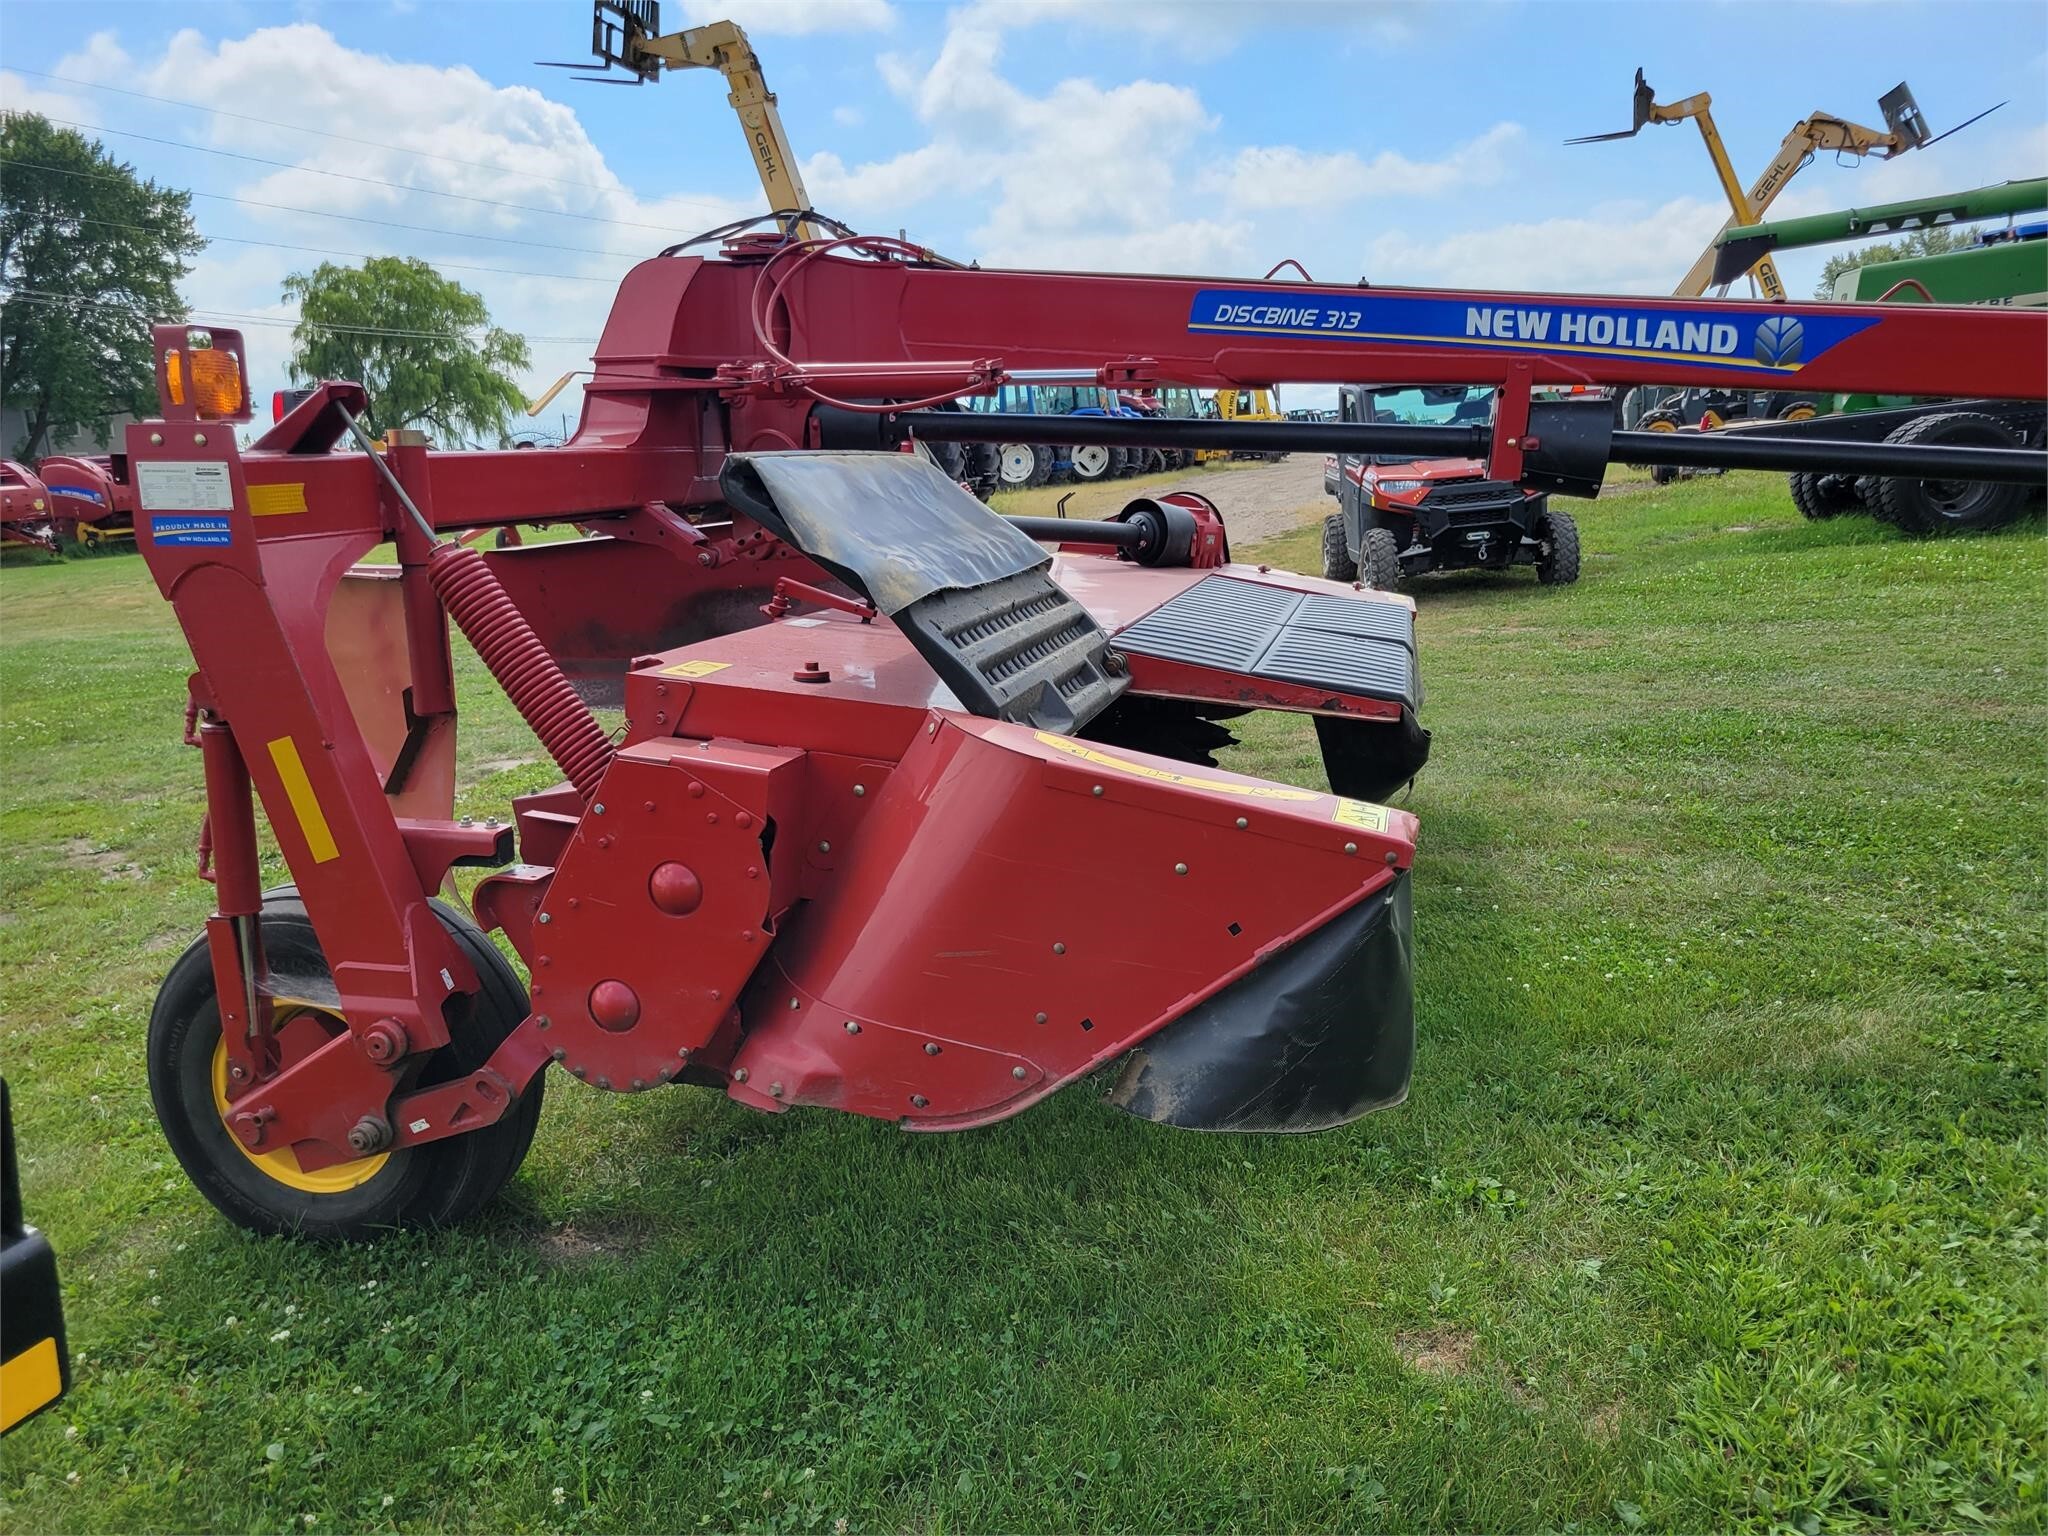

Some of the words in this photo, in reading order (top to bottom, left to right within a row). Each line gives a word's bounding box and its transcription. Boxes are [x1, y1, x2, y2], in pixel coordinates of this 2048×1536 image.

[755, 132, 777, 183] GEHL
[1755, 160, 1791, 202] GEHL
[1214, 304, 1320, 328] DISCBINE
[1321, 309, 1362, 330] 313
[1466, 307, 1552, 341] NEW
[1559, 312, 1739, 355] HOLLAND
[155, 523, 191, 531] PROUDLY
